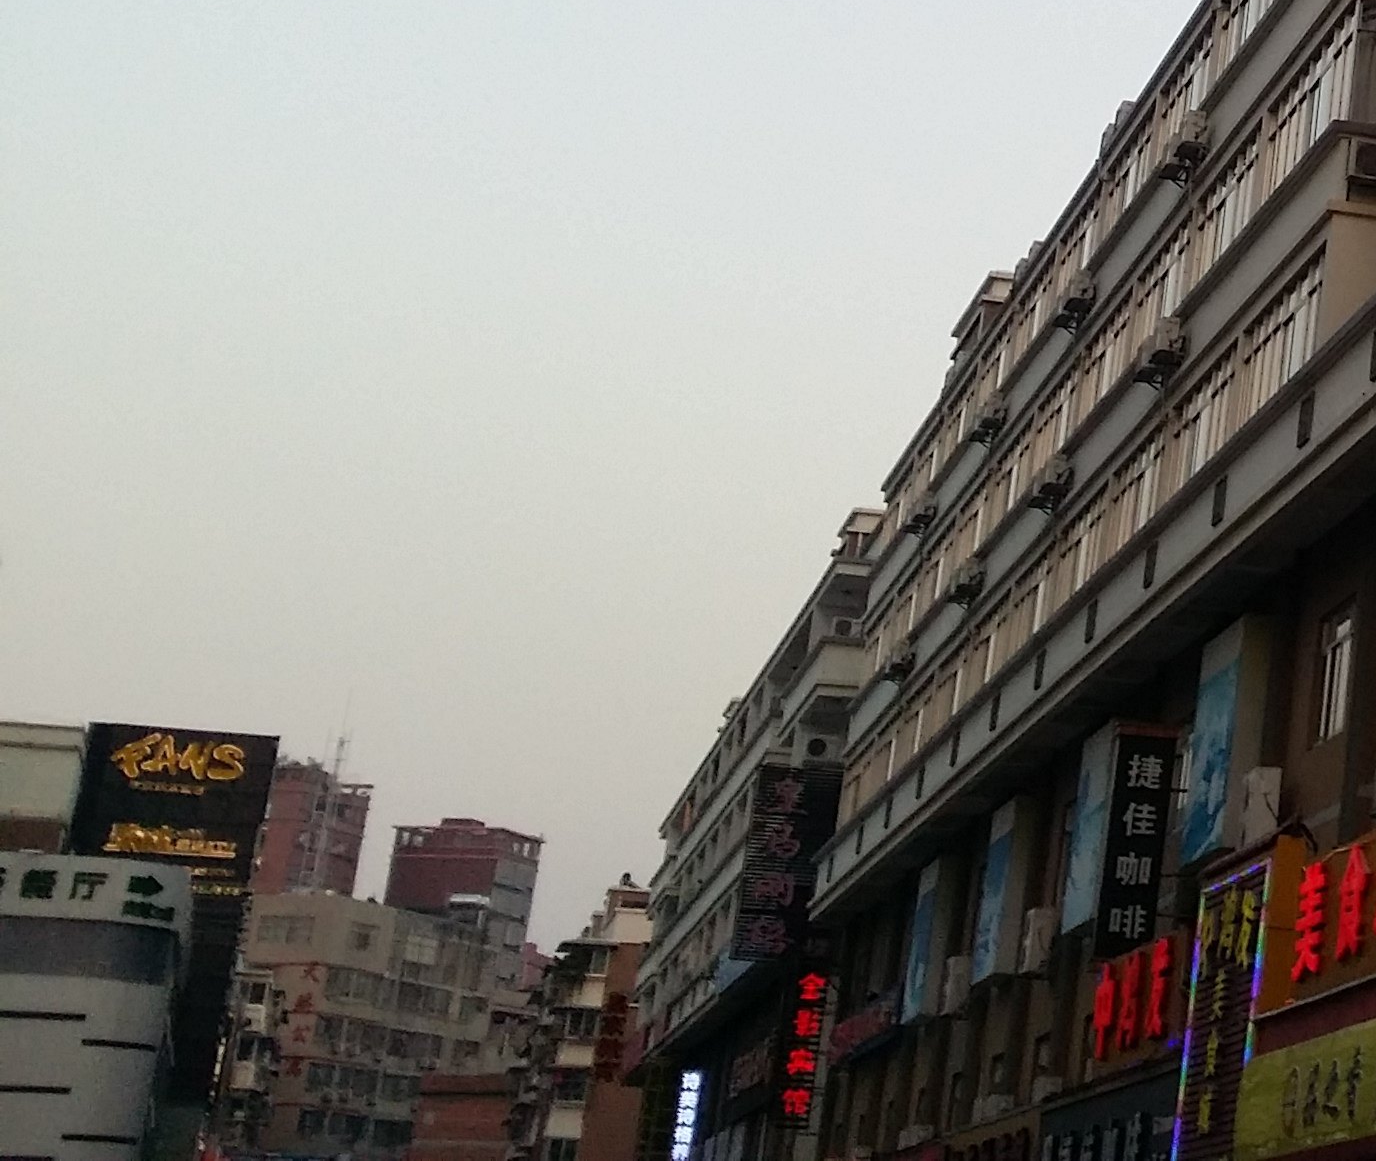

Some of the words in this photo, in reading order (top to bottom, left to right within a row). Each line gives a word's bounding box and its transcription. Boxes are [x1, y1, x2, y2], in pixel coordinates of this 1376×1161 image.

[111, 731, 246, 781] FANS
[1108, 753, 1165, 940] 捷佳咖啡
